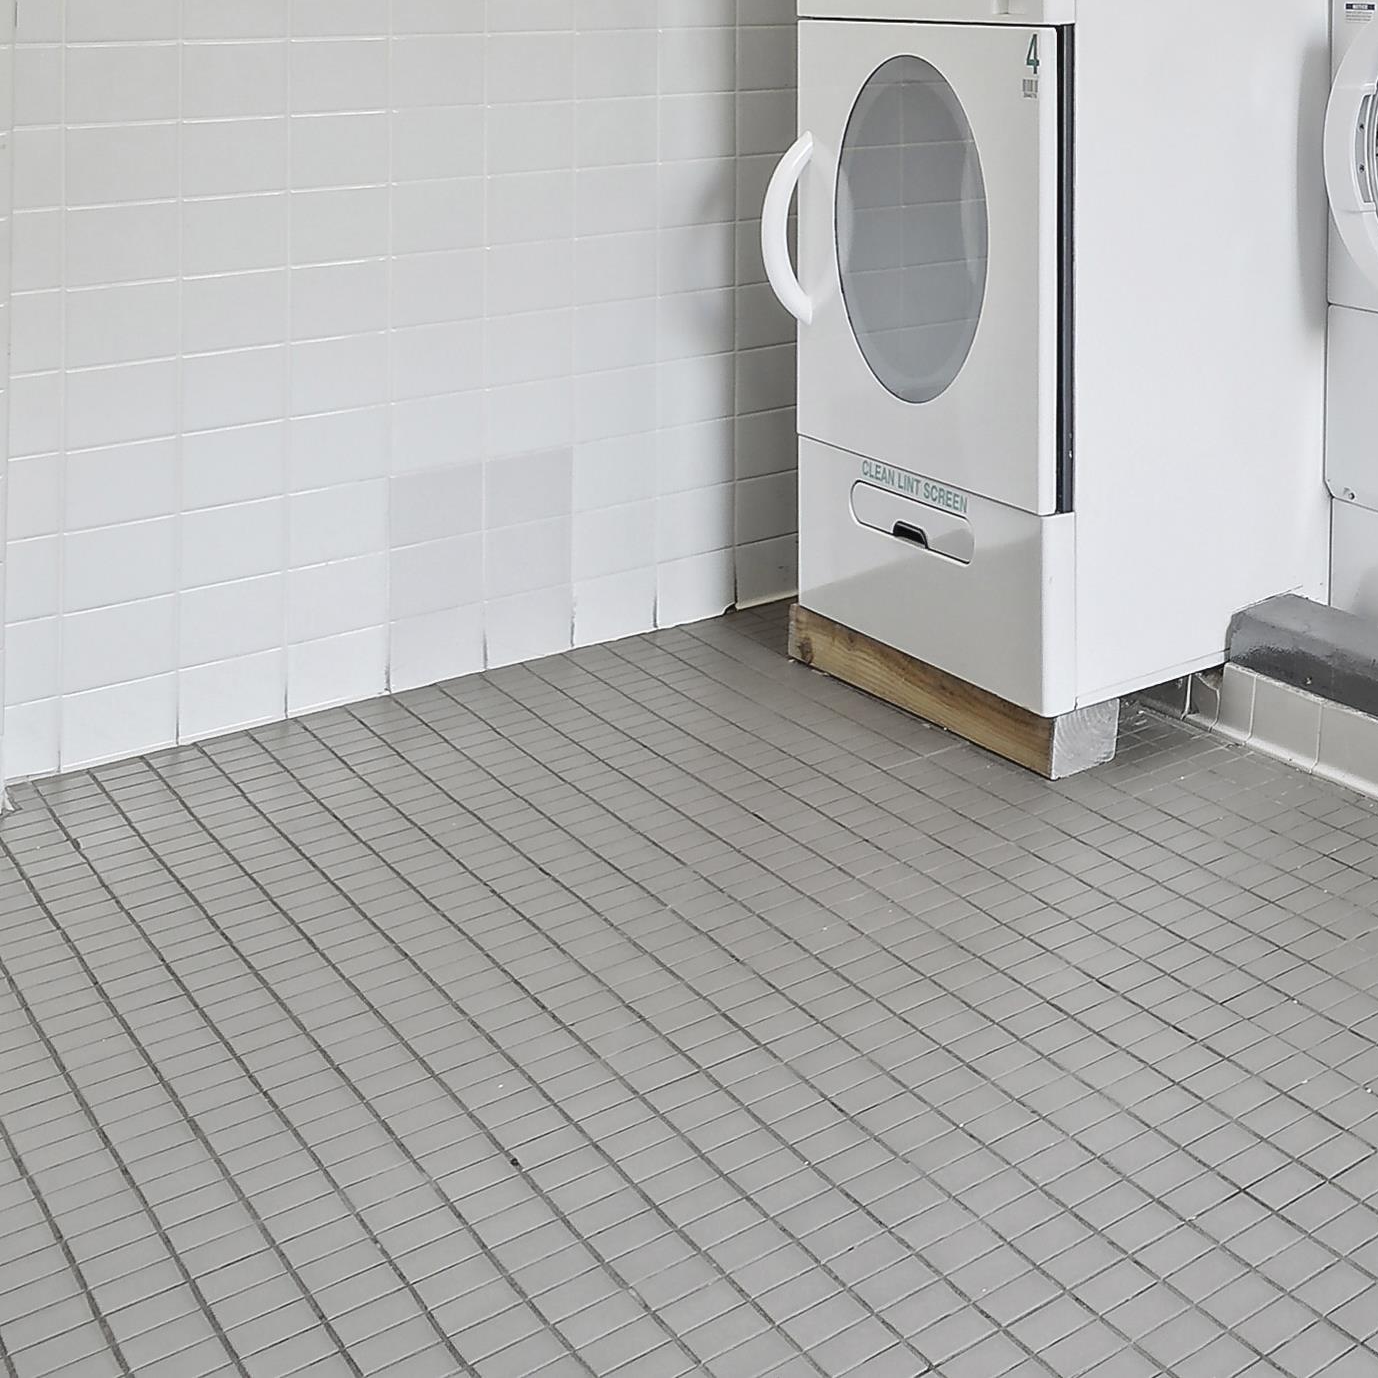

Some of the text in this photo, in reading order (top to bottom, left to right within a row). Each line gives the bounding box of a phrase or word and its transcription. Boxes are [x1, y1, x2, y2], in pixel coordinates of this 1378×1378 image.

[1025, 33, 1039, 75] 4
[861, 460, 968, 514] CLEAN LINT SCREEN
